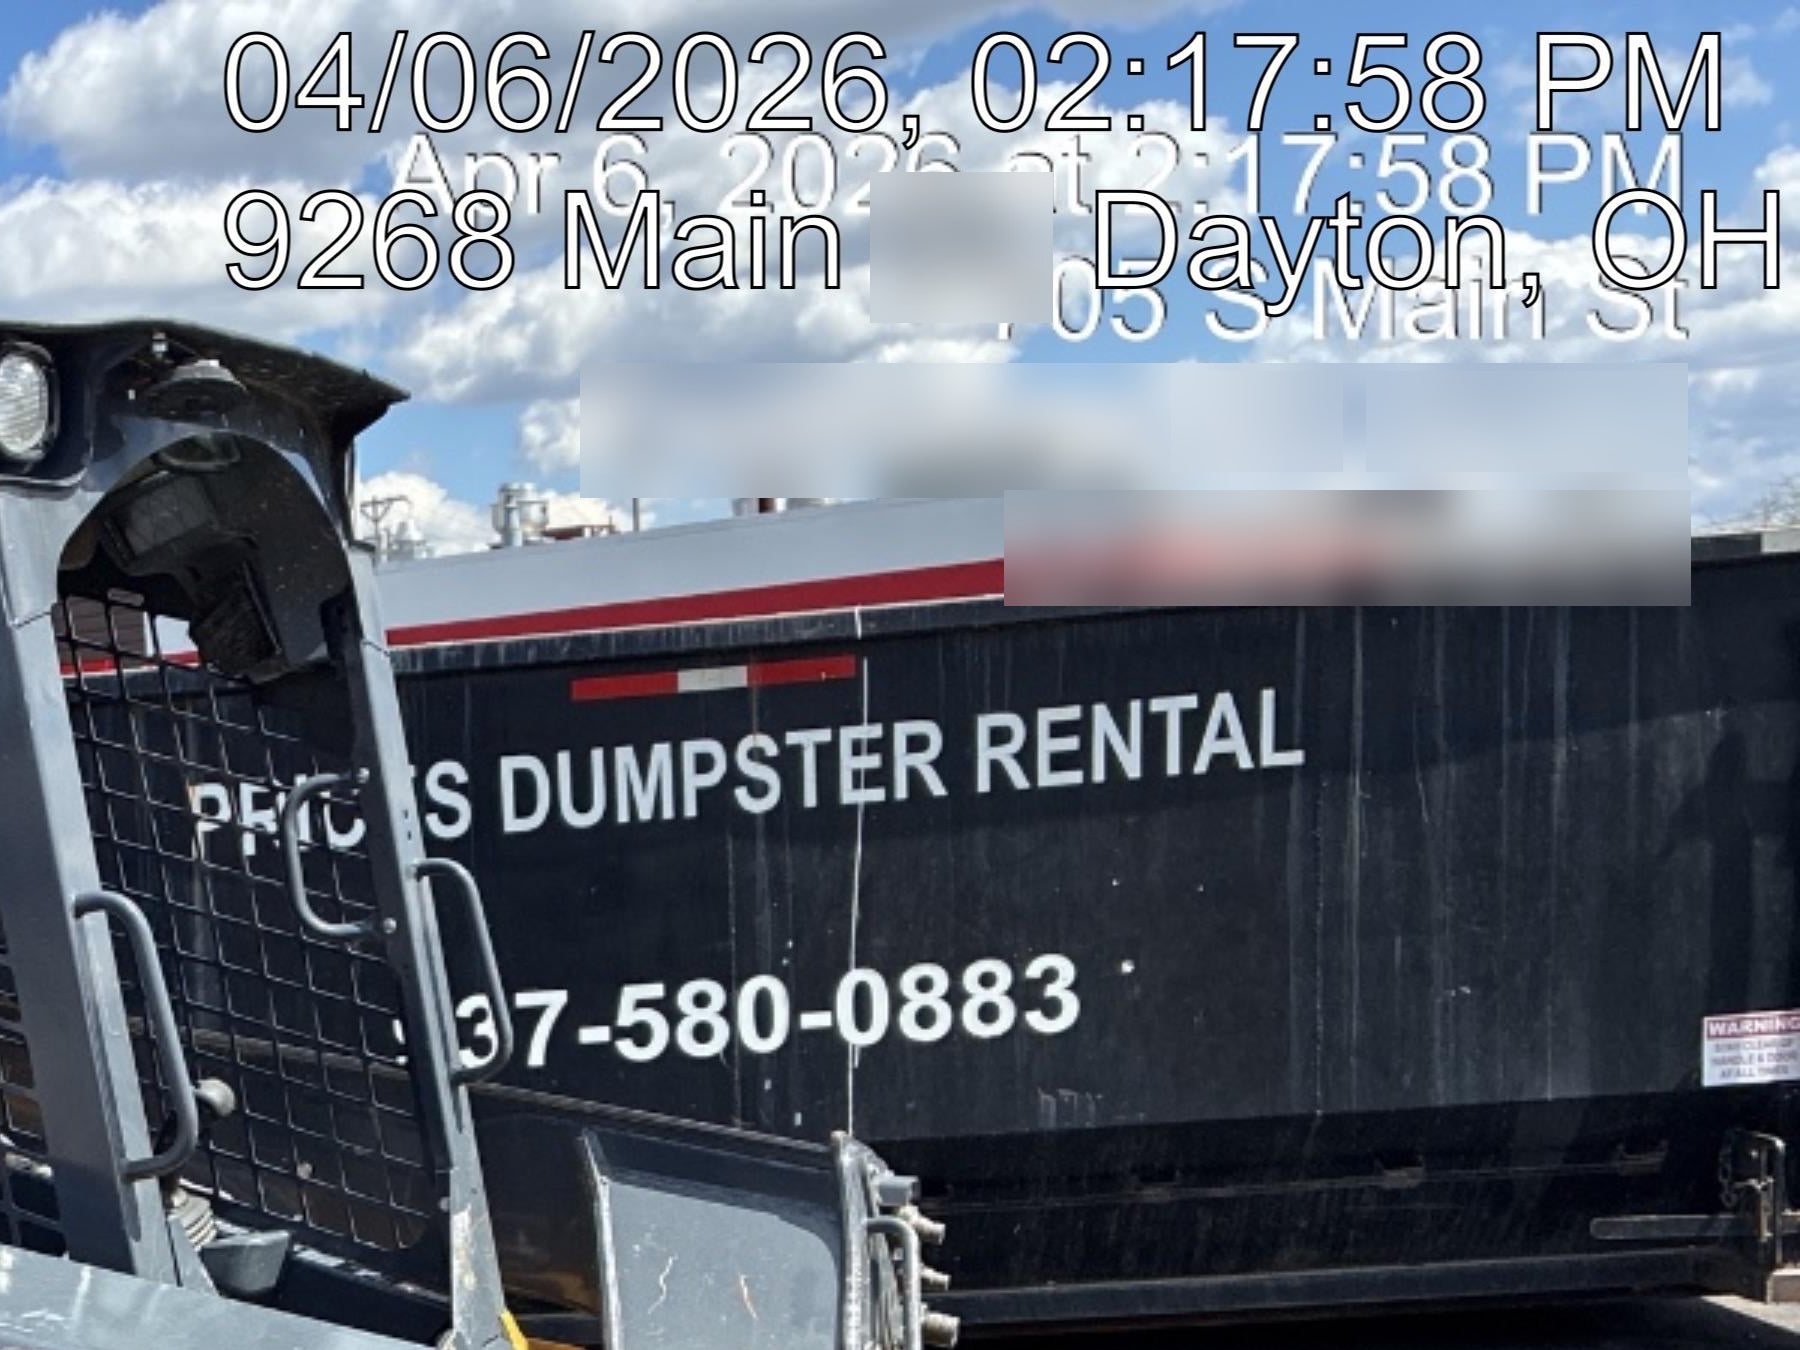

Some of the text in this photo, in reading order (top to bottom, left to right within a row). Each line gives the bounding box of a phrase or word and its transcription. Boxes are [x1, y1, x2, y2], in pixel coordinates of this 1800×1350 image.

[188, 688, 1305, 859] PRICS DUMPSTER RENTAL
[392, 952, 1082, 1069] 37-580-0883
